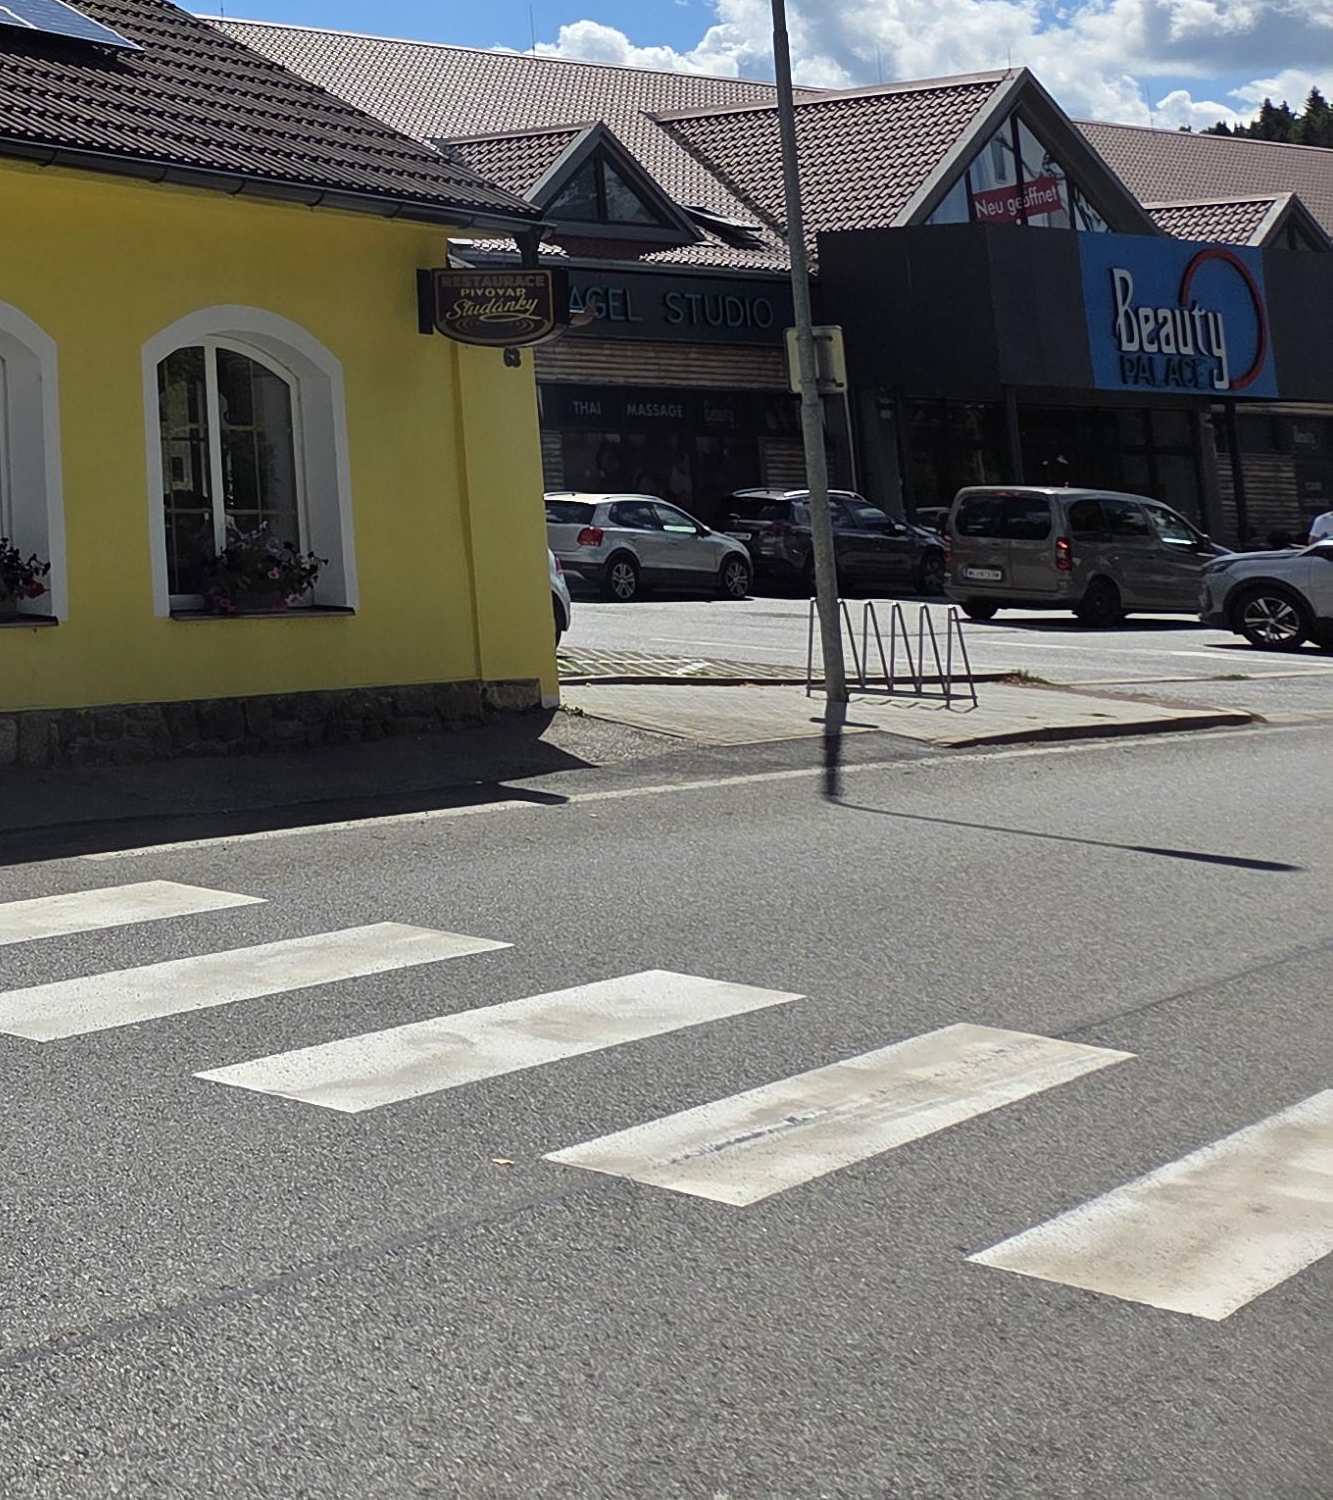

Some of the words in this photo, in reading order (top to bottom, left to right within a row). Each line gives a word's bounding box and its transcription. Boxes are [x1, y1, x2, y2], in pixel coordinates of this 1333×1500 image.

[975, 199, 1004, 218] Neu
[1007, 184, 1058, 215] geöffnet
[440, 275, 546, 287] RESTAURACE
[460, 287, 527, 297] PIVOVAR
[445, 294, 543, 323] Studánky
[664, 291, 775, 329] STUDIO
[1111, 267, 1230, 390] Beauty
[1119, 354, 1207, 389] PALACE
[572, 400, 602, 416] THAI
[626, 402, 684, 418] MASSAGE
